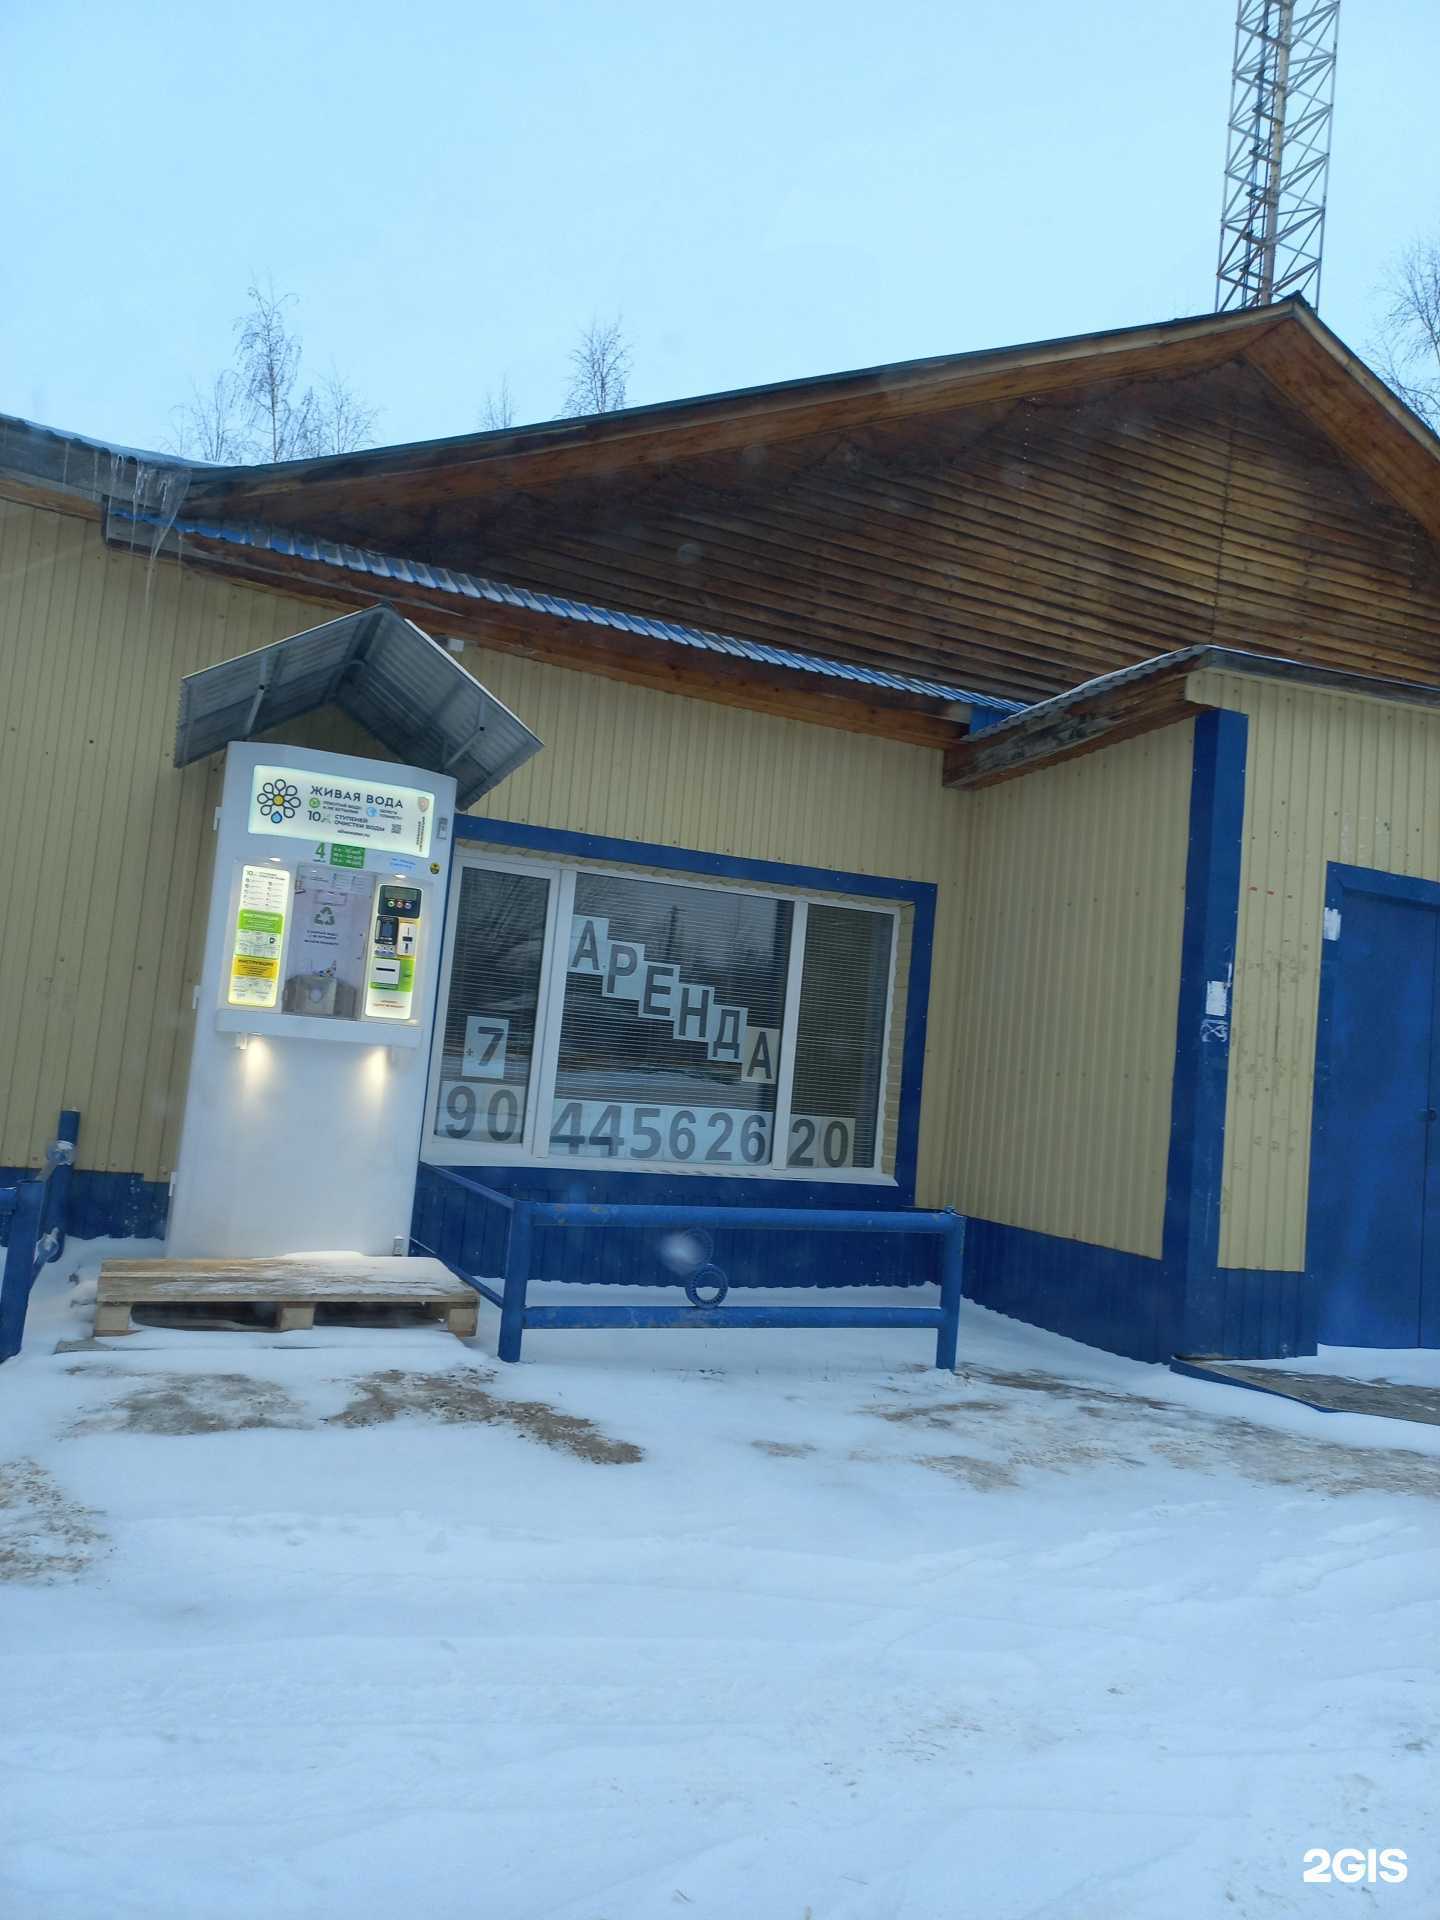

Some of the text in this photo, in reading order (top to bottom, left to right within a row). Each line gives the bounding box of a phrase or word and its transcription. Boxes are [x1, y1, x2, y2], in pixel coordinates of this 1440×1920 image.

[310, 785, 361, 802] ЖИВАЯ
[366, 794, 404, 809] ВОДА
[307, 810, 321, 822] 10
[315, 842, 325, 859] 4
[571, 919, 772, 1080] АРЕНДА
[445, 1085, 851, 1167] 90 445626 20
